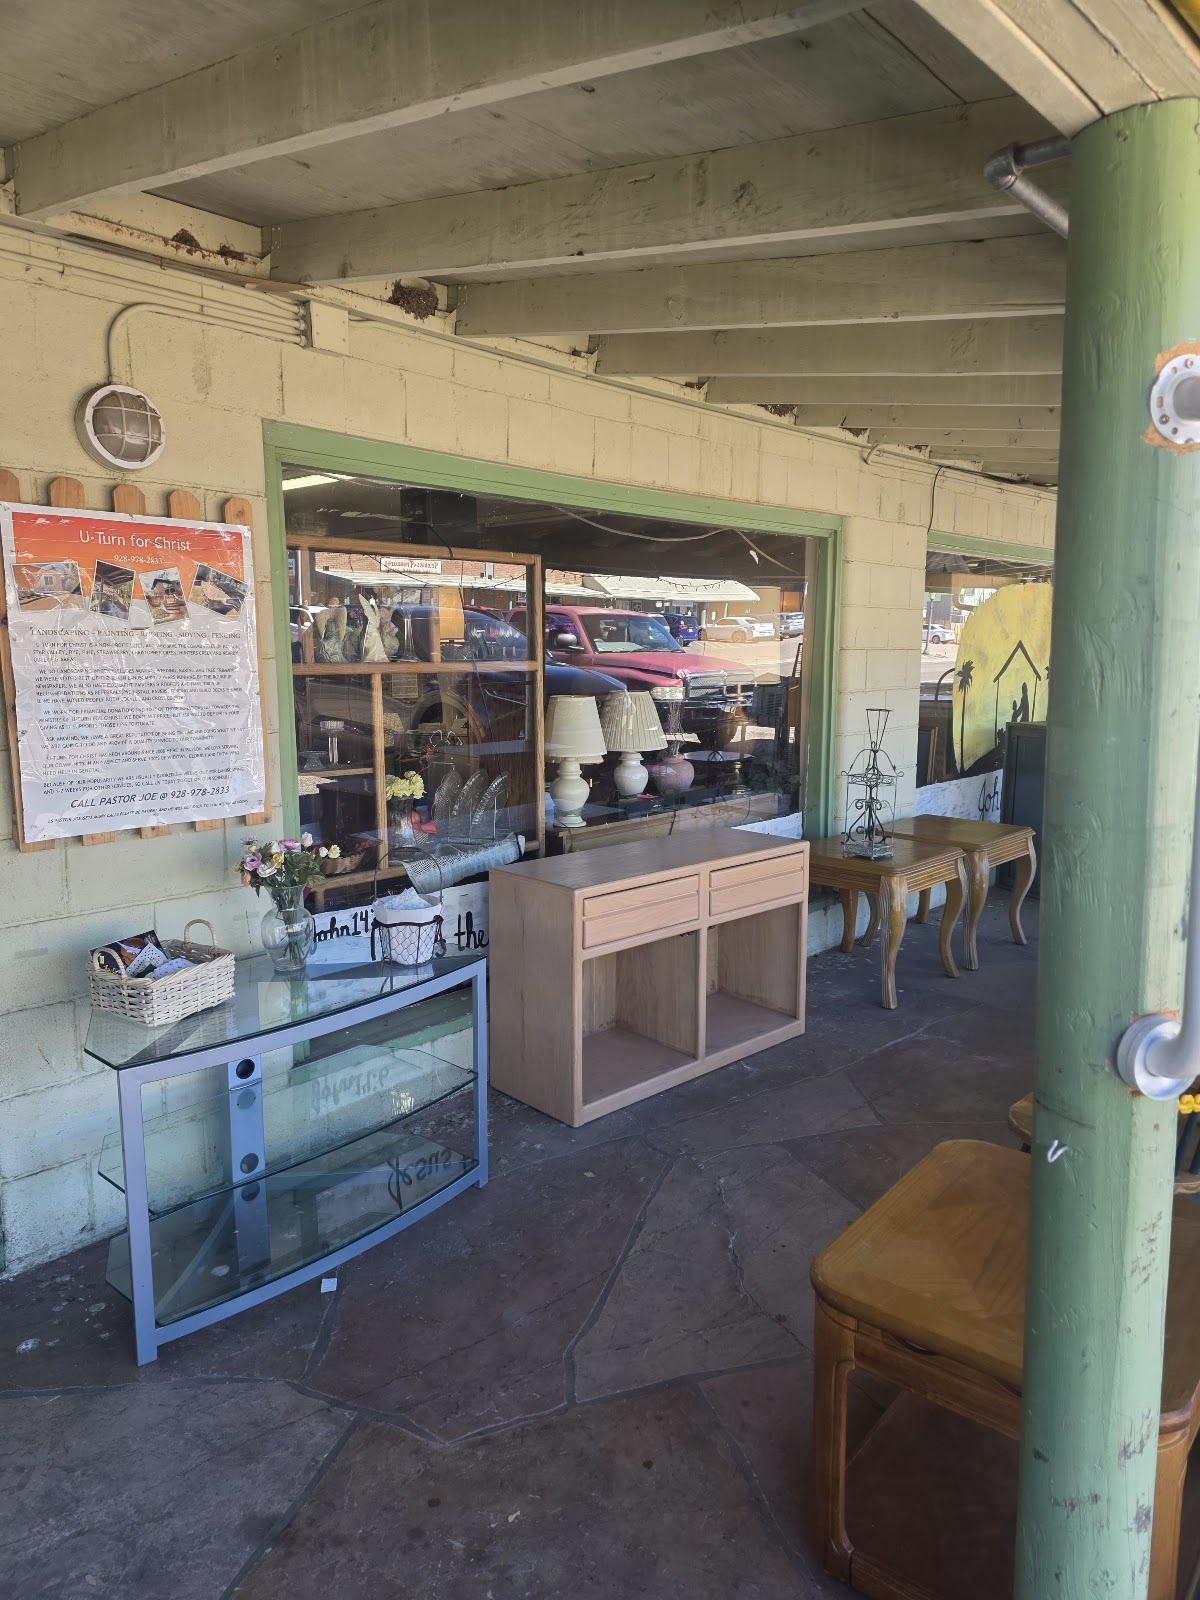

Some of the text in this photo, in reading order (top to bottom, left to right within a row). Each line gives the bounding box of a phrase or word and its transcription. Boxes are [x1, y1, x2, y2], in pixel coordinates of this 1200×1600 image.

[79, 529, 191, 551] U-Turn for Christ
[113, 554, 162, 564] 928-978-2833
[70, 785, 229, 809] CALL PASTOR JOE @ 928-978-2833
[978, 776, 999, 821] Joh
[454, 911, 490, 951] the
